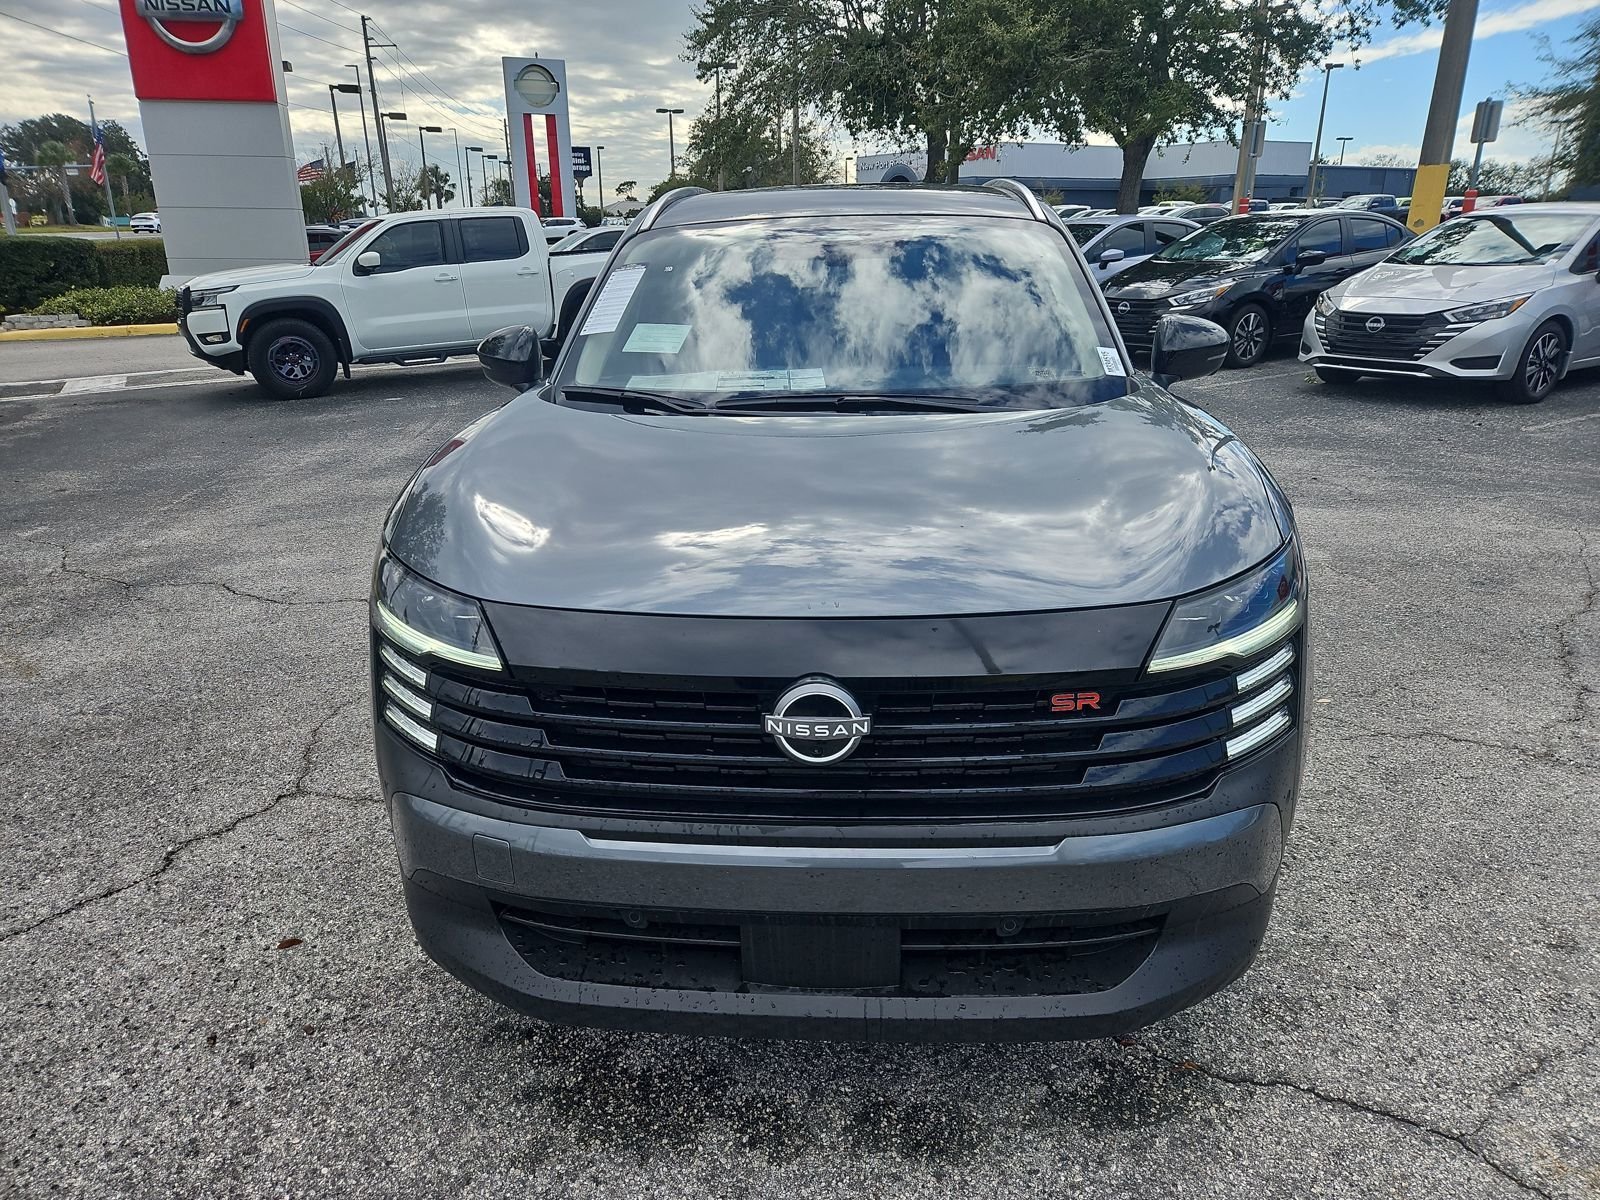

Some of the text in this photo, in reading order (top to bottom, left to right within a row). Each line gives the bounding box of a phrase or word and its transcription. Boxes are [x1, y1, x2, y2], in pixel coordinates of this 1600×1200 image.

[144, 0, 232, 13] NISSAN
[1051, 692, 1101, 712] SR
[767, 719, 868, 737] NISSAN
